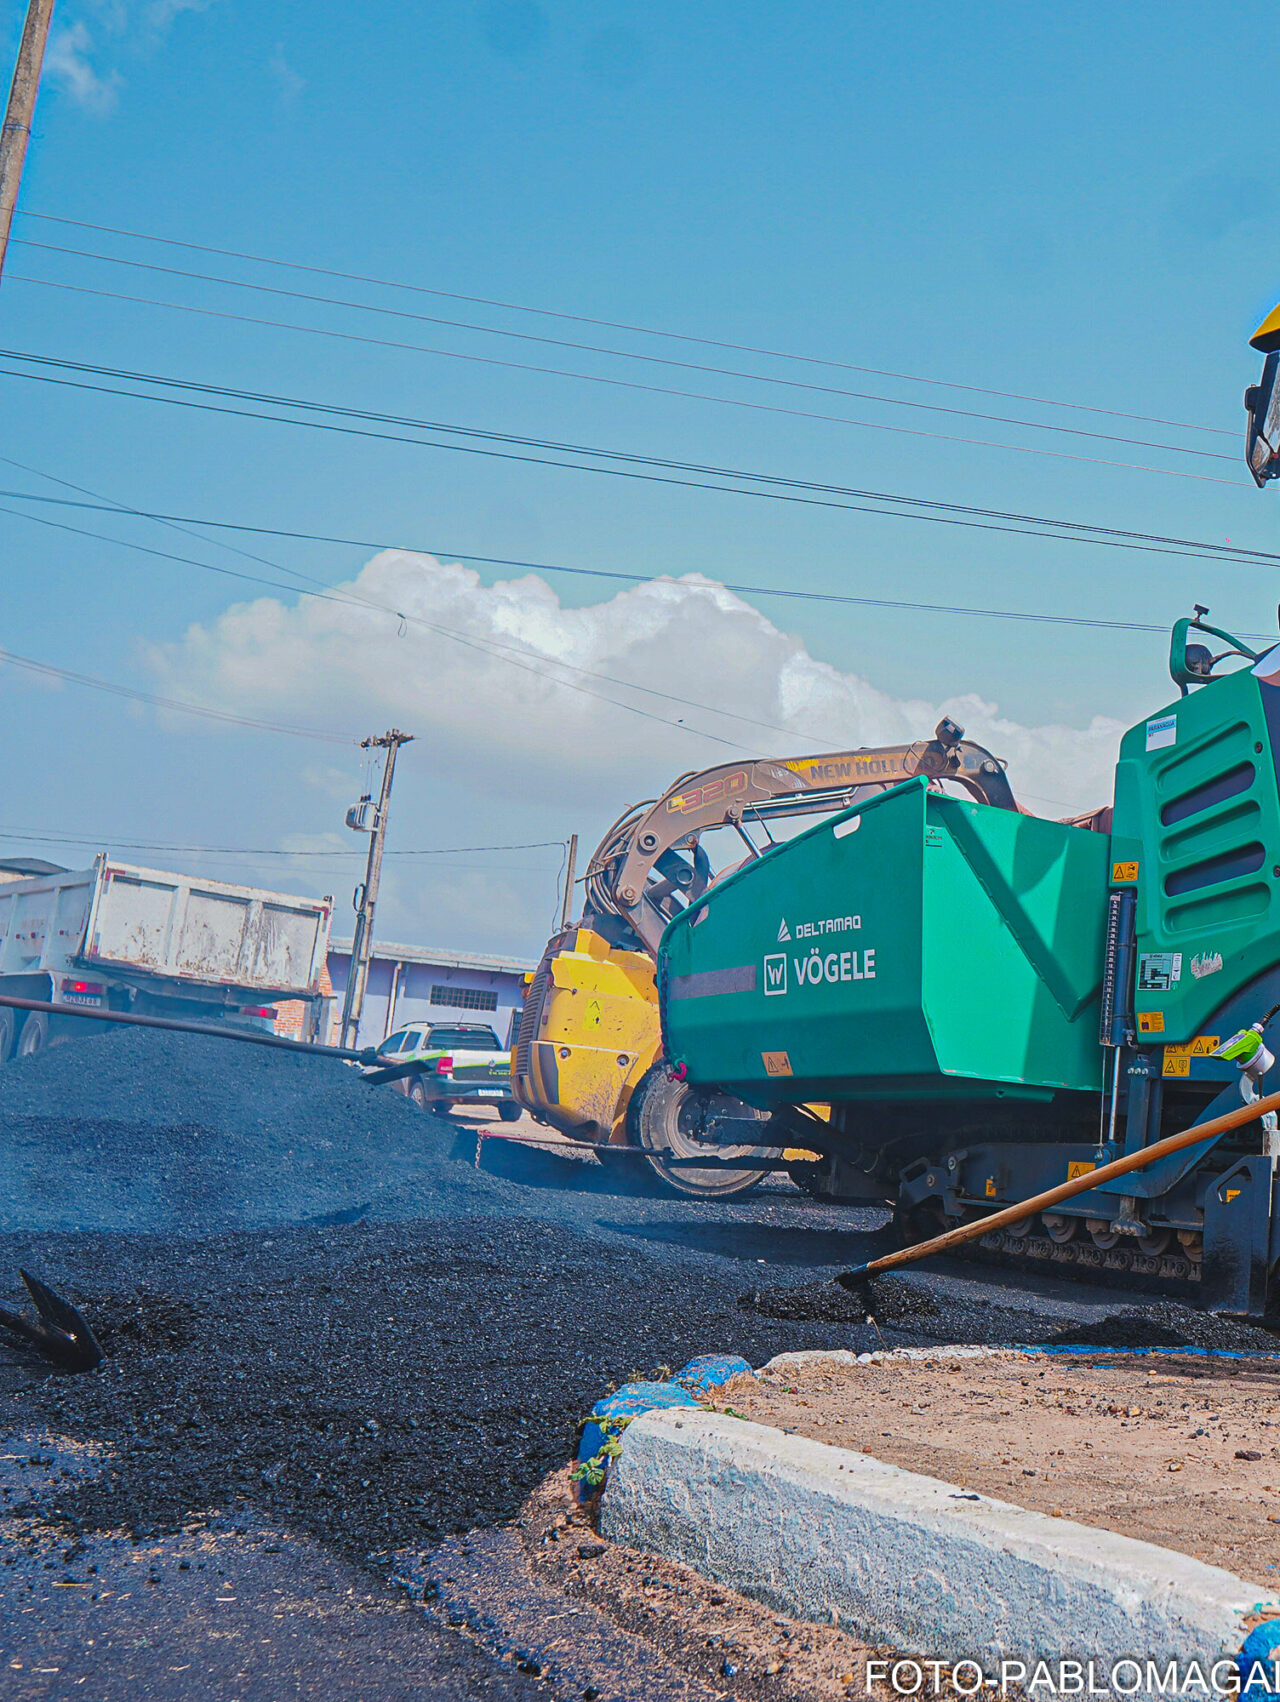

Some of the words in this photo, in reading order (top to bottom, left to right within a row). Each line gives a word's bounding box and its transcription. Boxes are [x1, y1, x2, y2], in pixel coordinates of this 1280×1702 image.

[810, 764, 851, 779] NEW
[796, 915, 862, 939] DELTAMAQ
[793, 947, 876, 985] VÖGELE
